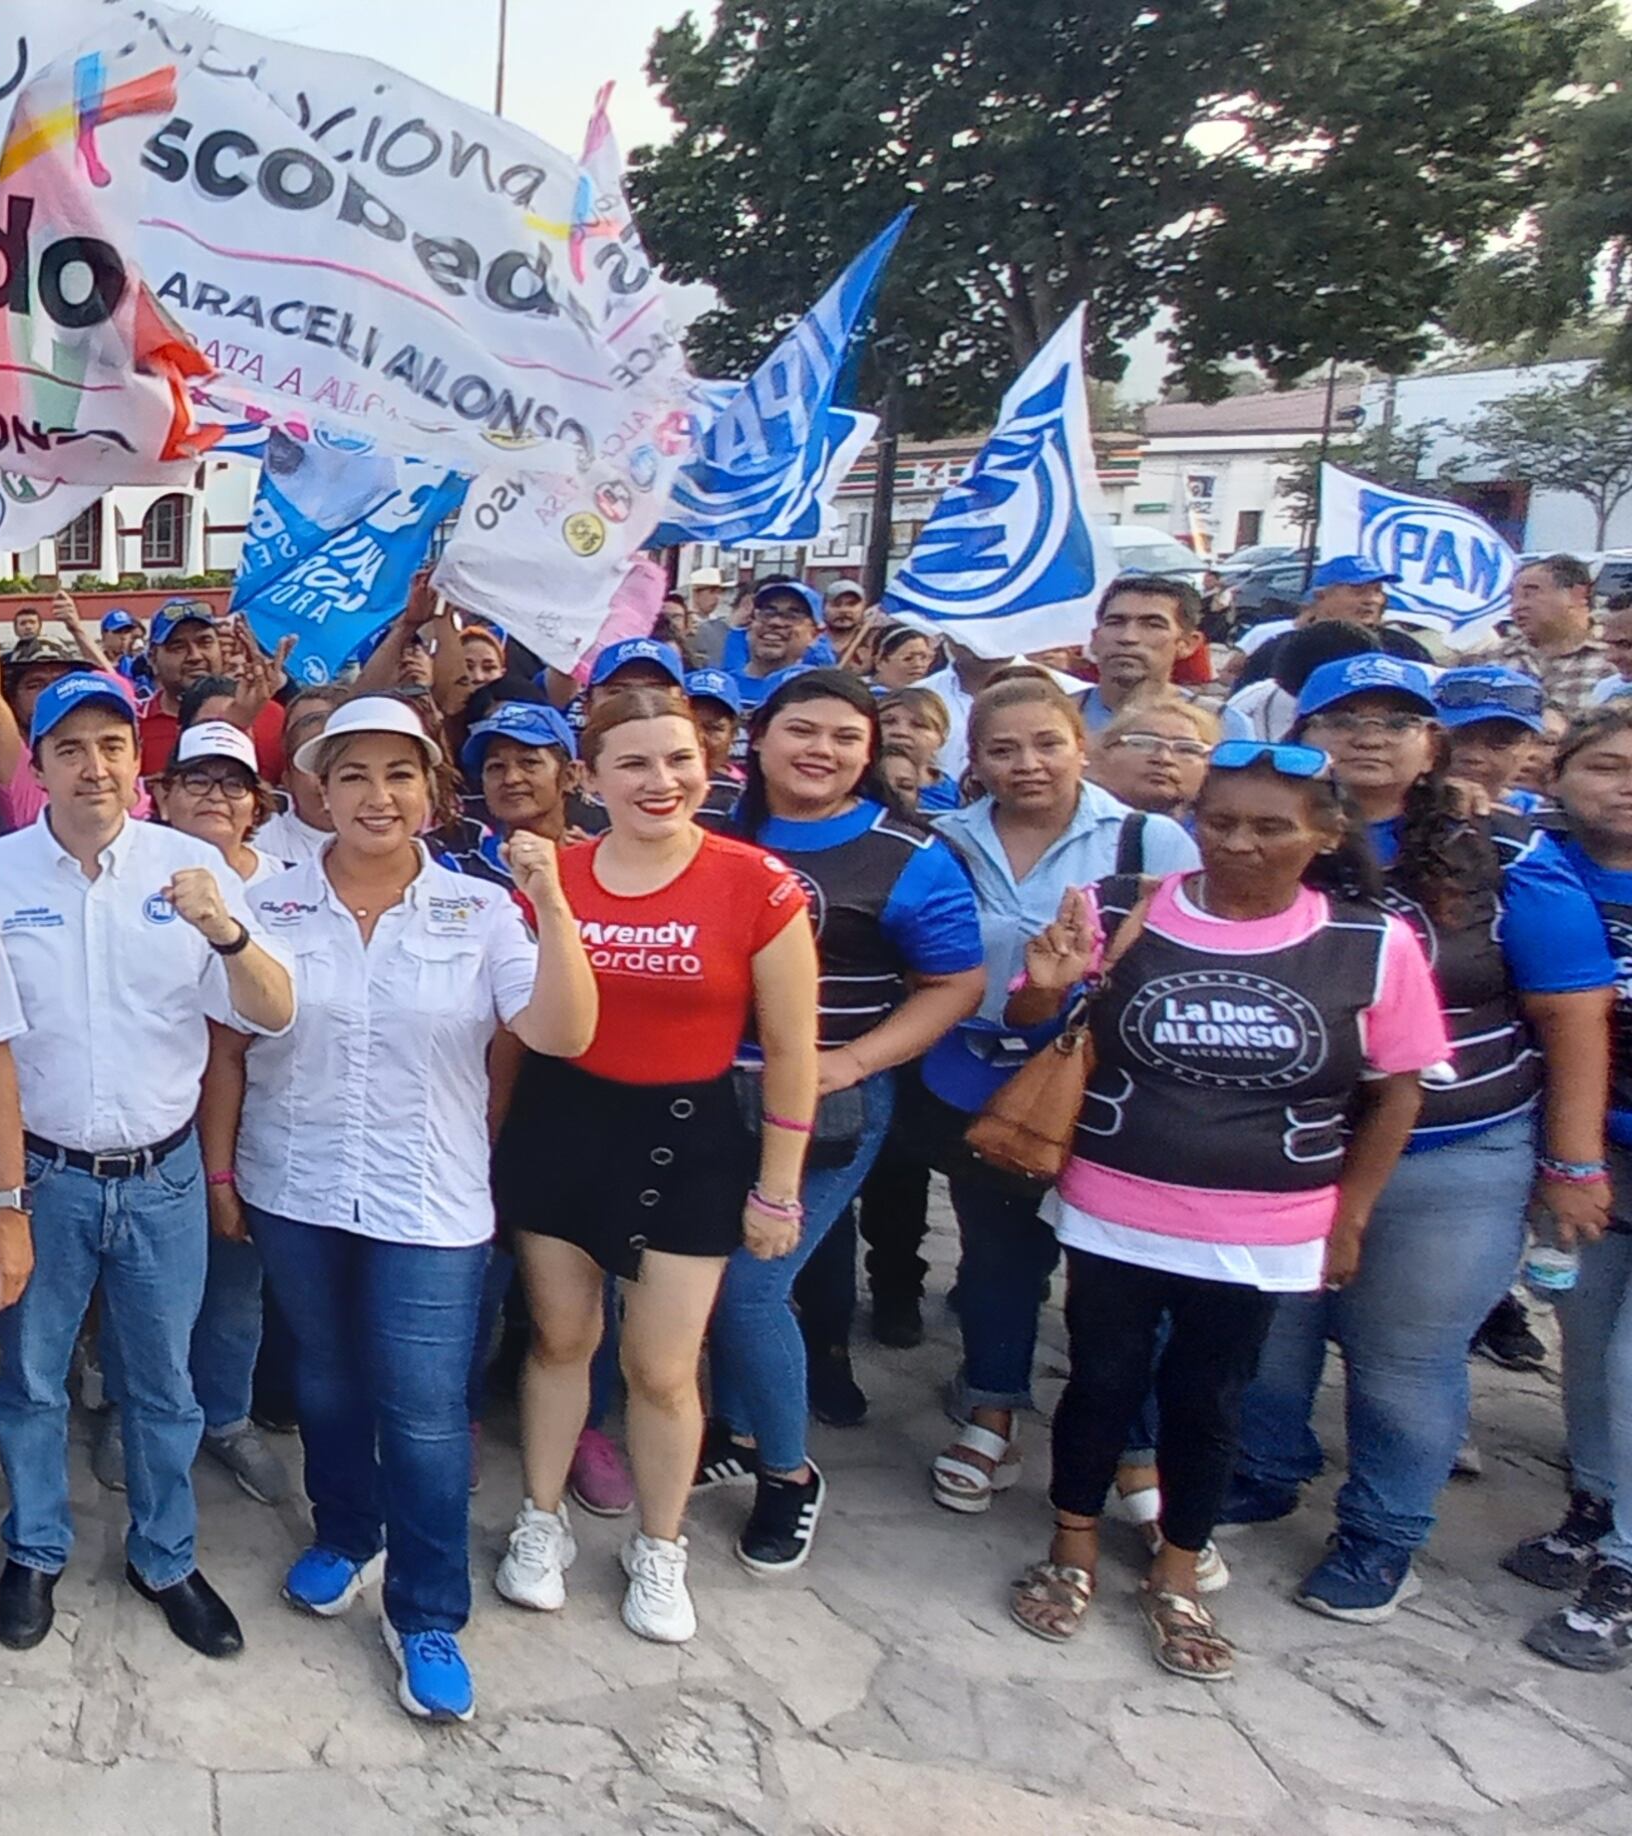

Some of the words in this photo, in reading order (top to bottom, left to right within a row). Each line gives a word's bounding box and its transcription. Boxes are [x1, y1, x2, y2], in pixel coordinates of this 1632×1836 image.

[157, 272, 377, 367] ARACELI
[196, 332, 266, 384] ATA
[1390, 522, 1504, 601] PAN
[590, 948, 701, 974] ordero
[1165, 998, 1207, 1023] La
[1210, 1000, 1279, 1024] Doc
[1153, 1021, 1299, 1049] ALONSO
